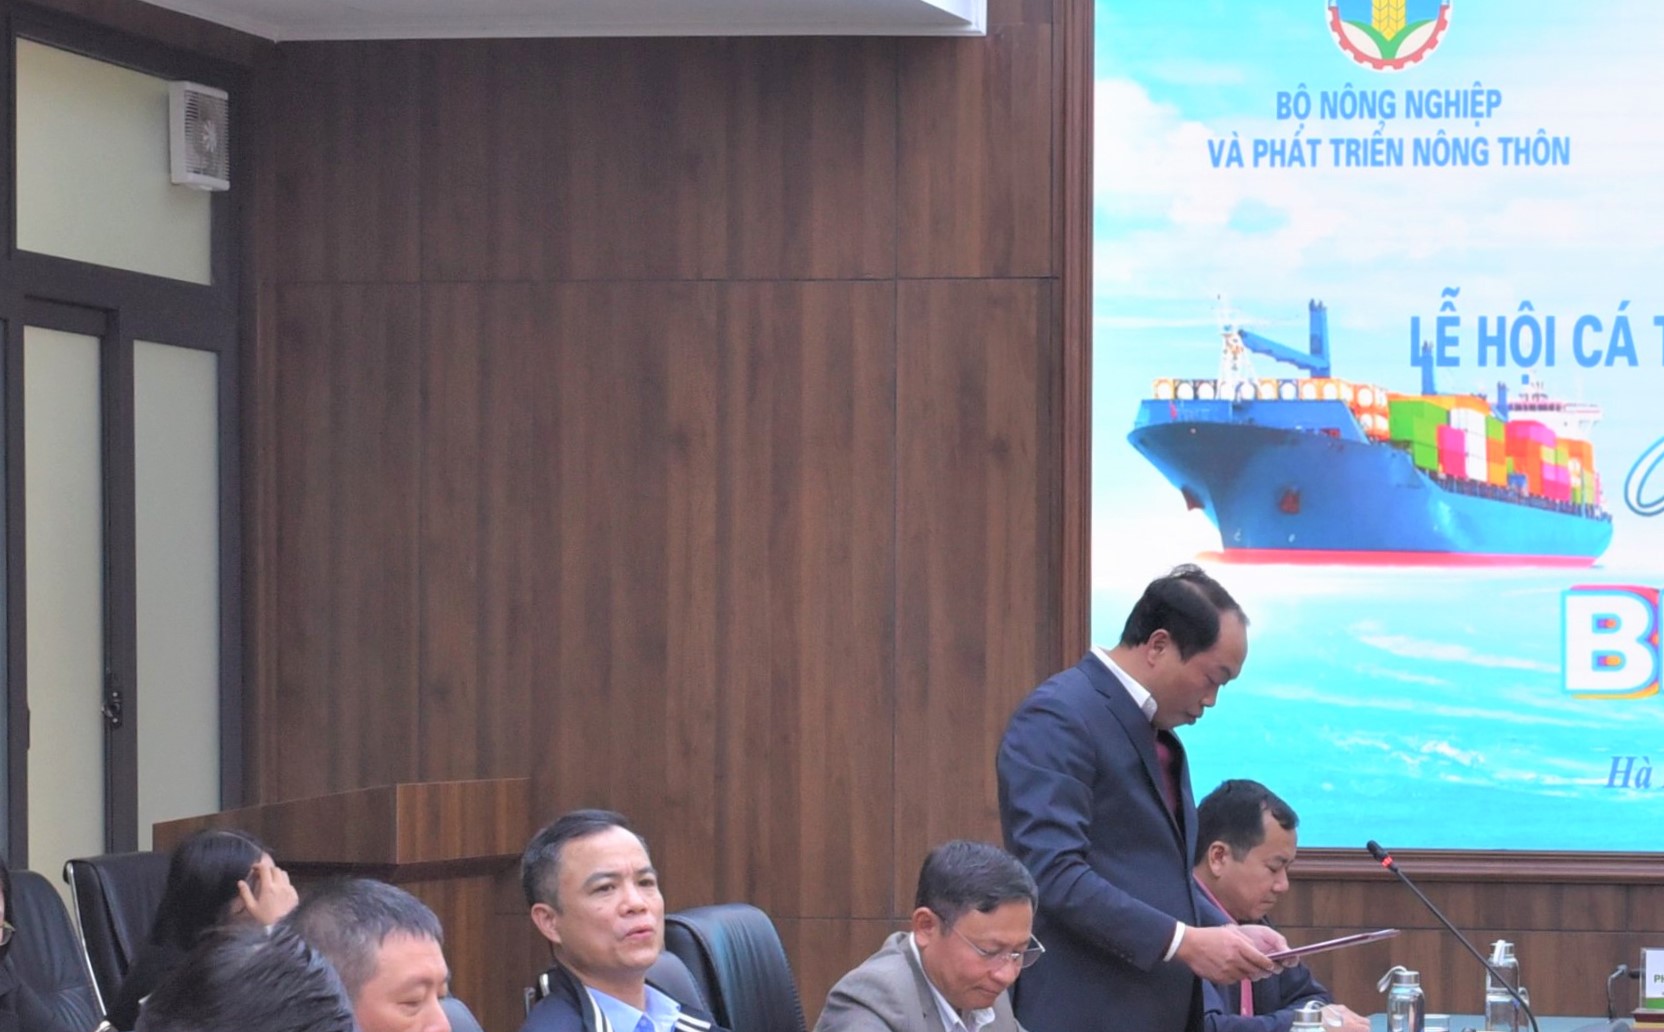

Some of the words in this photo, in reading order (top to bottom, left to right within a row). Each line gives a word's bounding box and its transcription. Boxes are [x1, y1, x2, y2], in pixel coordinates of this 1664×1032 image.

[1276, 82, 1312, 130] BỘ
[1320, 82, 1396, 120] NÔNG
[1405, 81, 1502, 128] NGHIỆP
[1207, 131, 1244, 168] VÀ
[1253, 130, 1322, 168] PHÁT
[1329, 120, 1403, 167] TRIỂN
[1412, 129, 1490, 167] NÔNG
[1497, 128, 1571, 166] THÔN
[1410, 287, 1461, 368] LỄ
[1477, 300, 1556, 385] HỘI
[1572, 300, 1639, 368] CÁ
[1603, 755, 1651, 790] Hà
